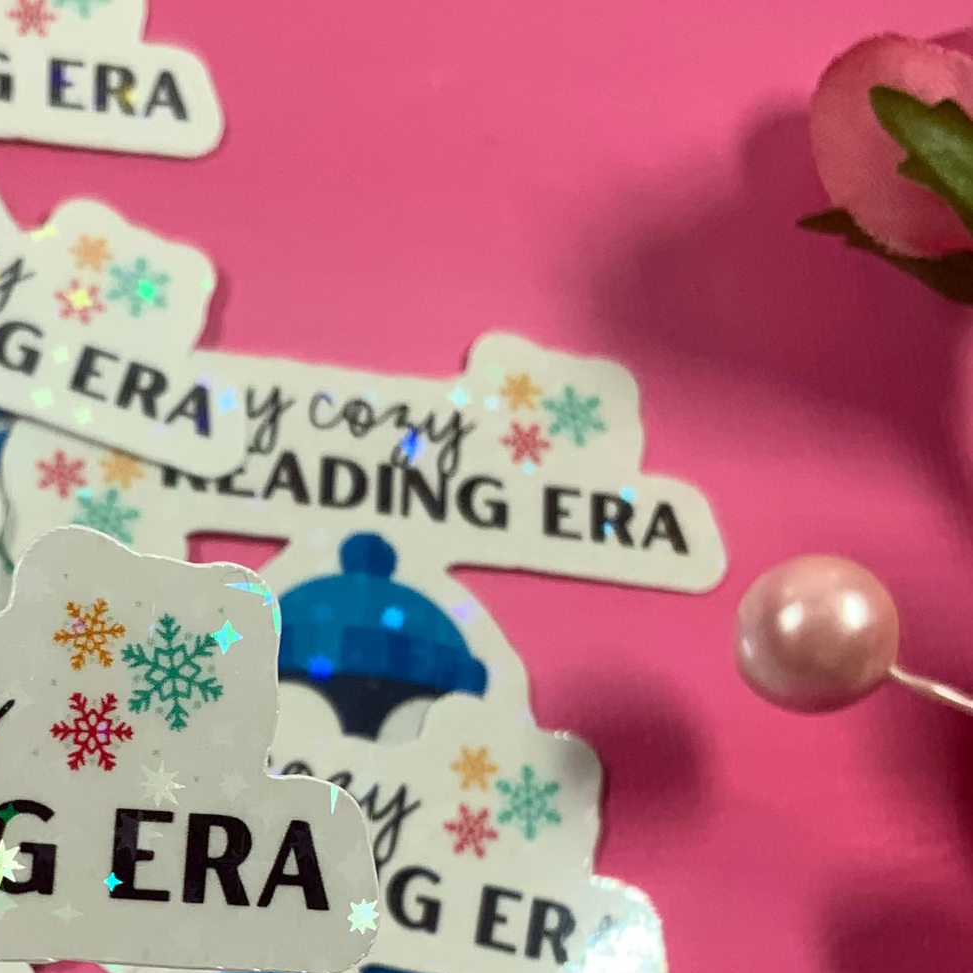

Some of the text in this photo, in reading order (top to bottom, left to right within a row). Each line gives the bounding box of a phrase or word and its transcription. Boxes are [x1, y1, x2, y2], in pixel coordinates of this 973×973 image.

[48, 58, 190, 122] ERA
[67, 346, 214, 438] ERA
[308, 389, 476, 477] cozy
[161, 450, 689, 556] ADING ERA
[111, 807, 331, 912] ERA
[474, 882, 615, 966] ER
